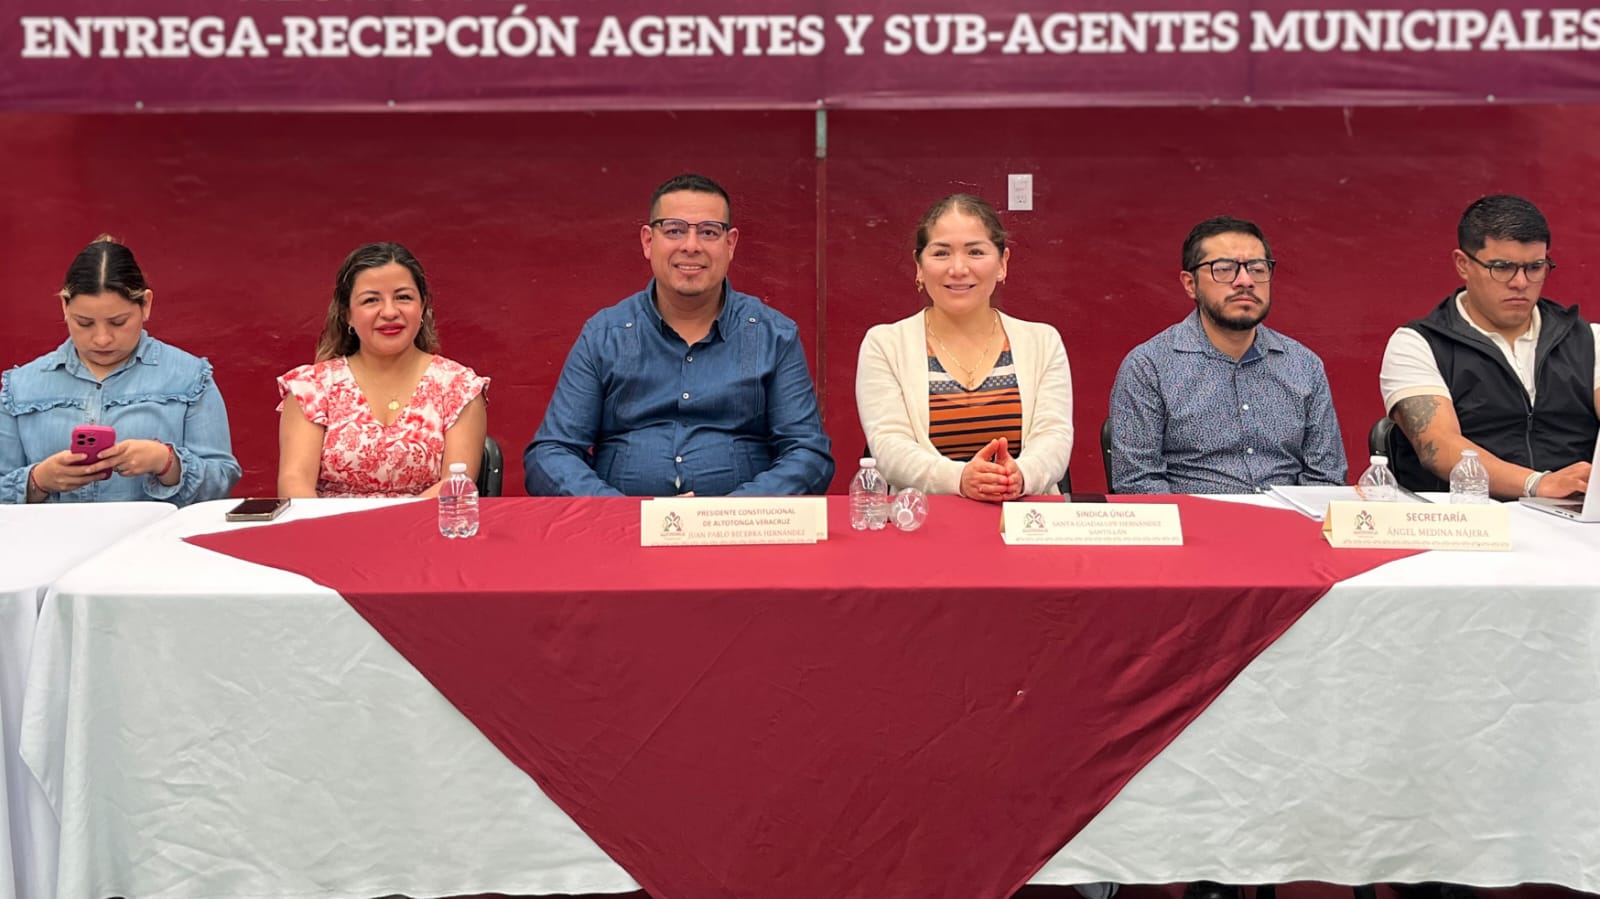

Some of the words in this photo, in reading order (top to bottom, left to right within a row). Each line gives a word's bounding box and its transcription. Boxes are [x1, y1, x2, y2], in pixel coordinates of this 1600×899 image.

[21, 5, 579, 58] ENTREGA-RECEPCIÓN
[590, 15, 825, 57] AGENTES
[835, 14, 874, 55] Y
[884, 12, 1240, 55] SUB-AGENTES
[1250, 9, 1600, 52] MUNICIPALES
[738, 508, 795, 516] CONSTITUCIONAL
[1110, 509, 1135, 518] ÚNICA
[1406, 512, 1467, 522] SECRETARÍA
[756, 518, 790, 526] VERACRUZ
[1419, 528, 1453, 536] MEDINA
